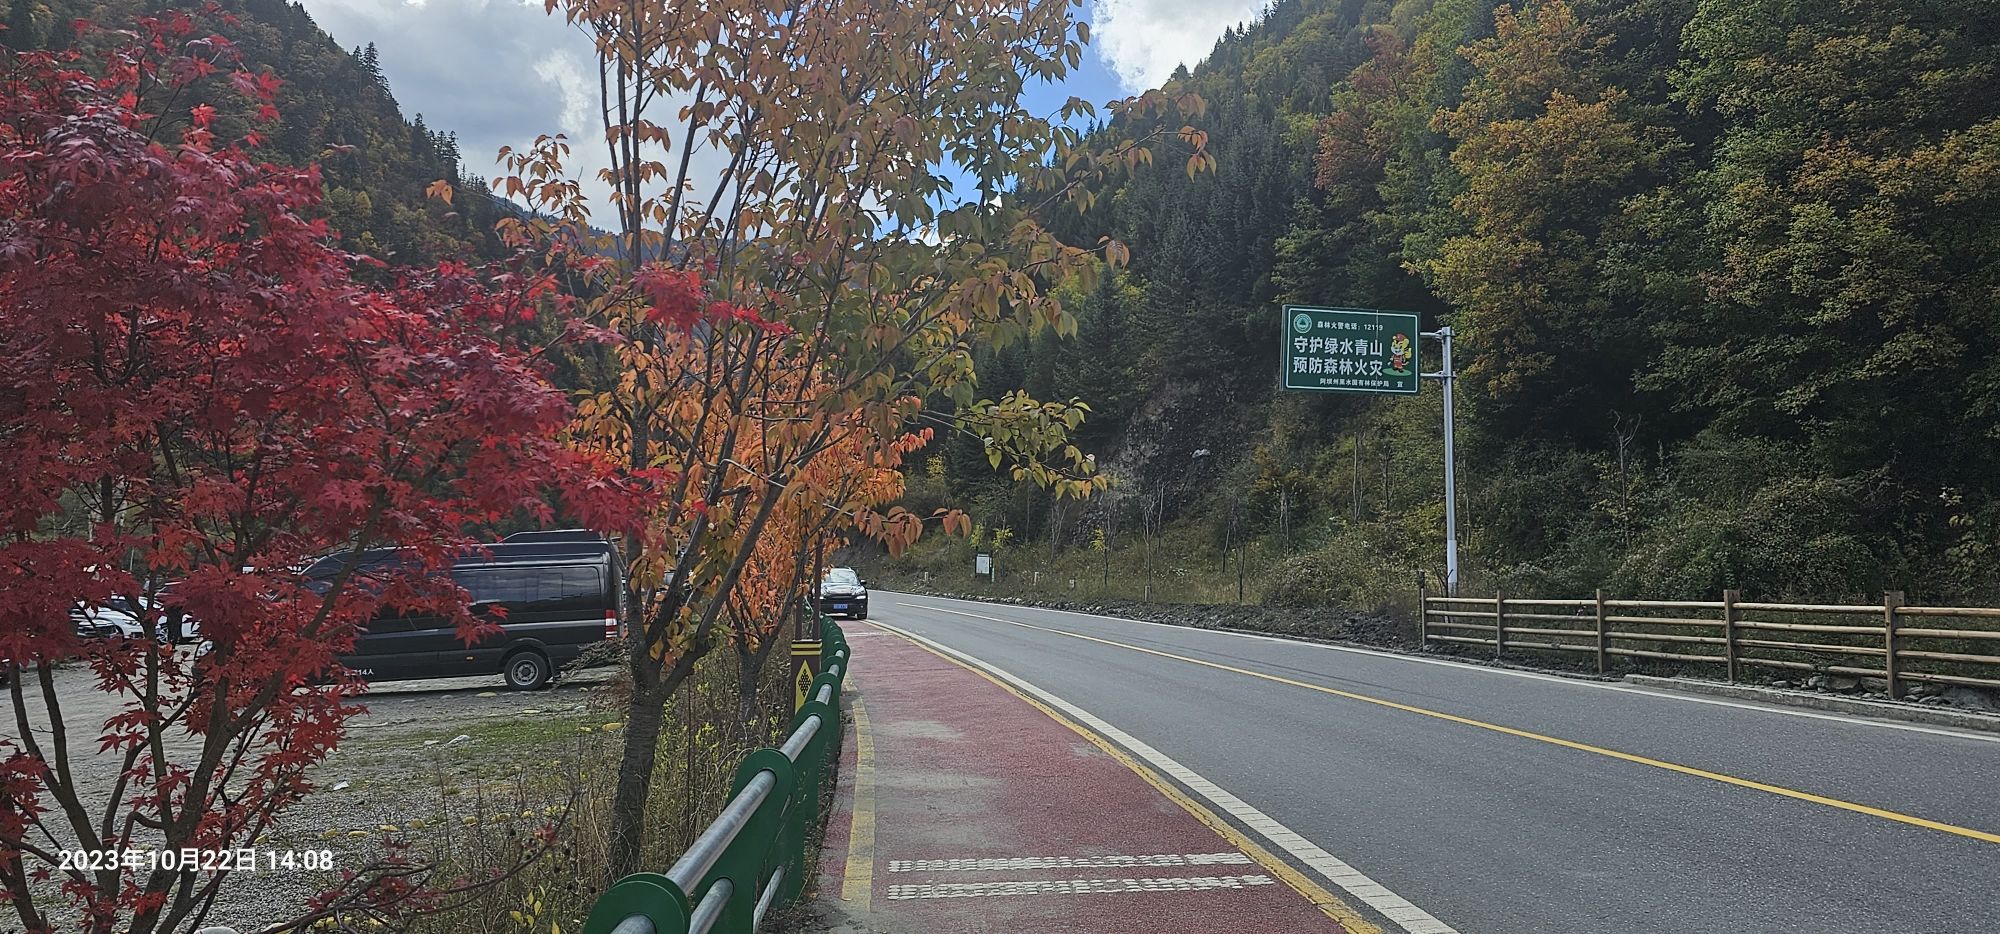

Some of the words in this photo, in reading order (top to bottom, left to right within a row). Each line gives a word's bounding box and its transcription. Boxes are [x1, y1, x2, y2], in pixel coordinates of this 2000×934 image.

[1293, 335, 1383, 357] 守护绿水青山
[1293, 356, 1383, 377] 预防森林火灾
